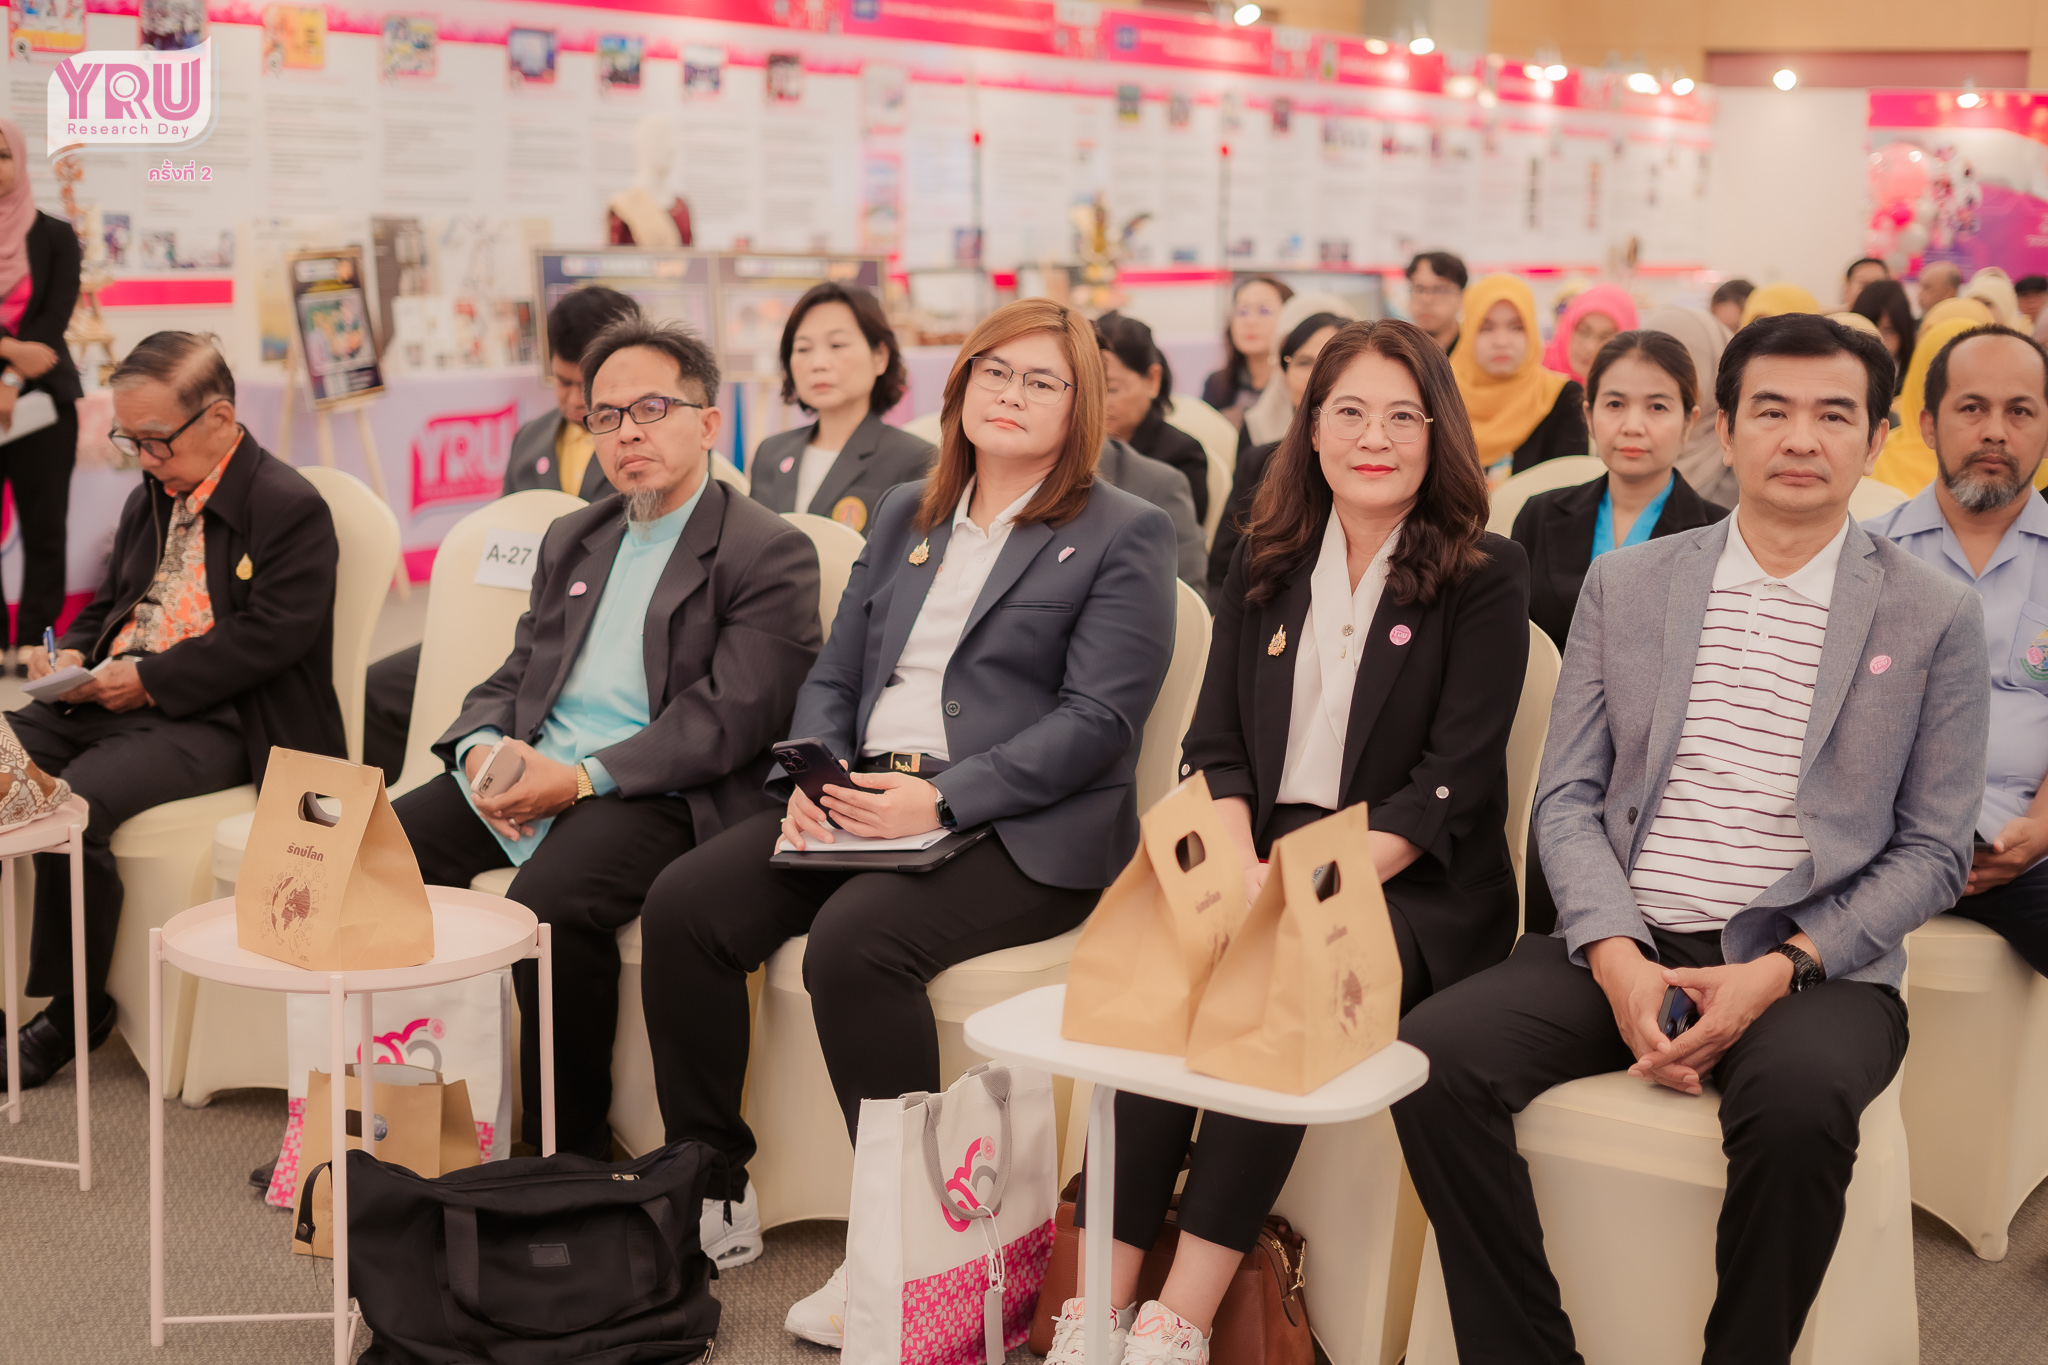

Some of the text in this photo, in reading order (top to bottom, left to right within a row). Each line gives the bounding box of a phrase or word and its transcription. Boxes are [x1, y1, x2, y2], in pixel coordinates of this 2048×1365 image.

[412, 415, 513, 483] YRU
[486, 544, 532, 565] A-27
[286, 842, 325, 862] รักษ์โลก
